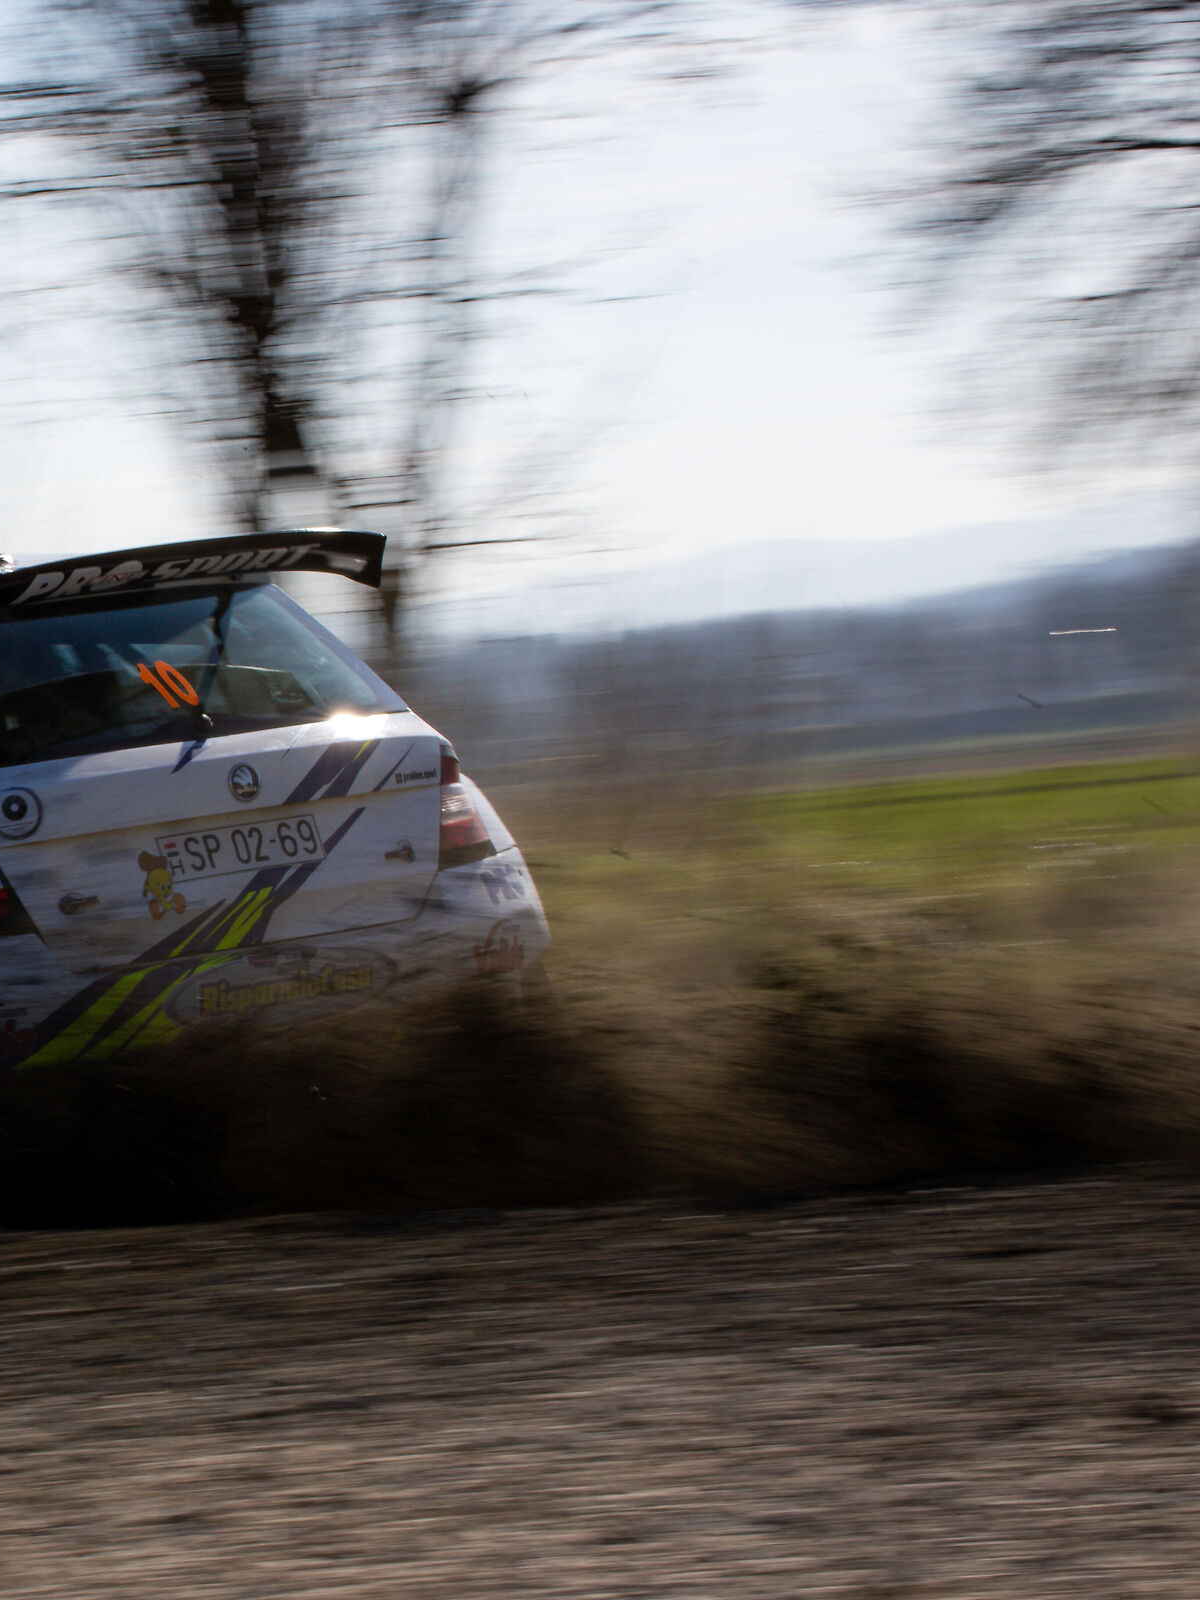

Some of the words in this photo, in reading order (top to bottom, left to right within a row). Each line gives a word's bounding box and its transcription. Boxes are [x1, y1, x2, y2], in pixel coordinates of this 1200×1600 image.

[151, 543, 321, 581] SPORT
[137, 659, 199, 708] 10
[184, 837, 220, 871] SP
[231, 819, 317, 864] 02-69
